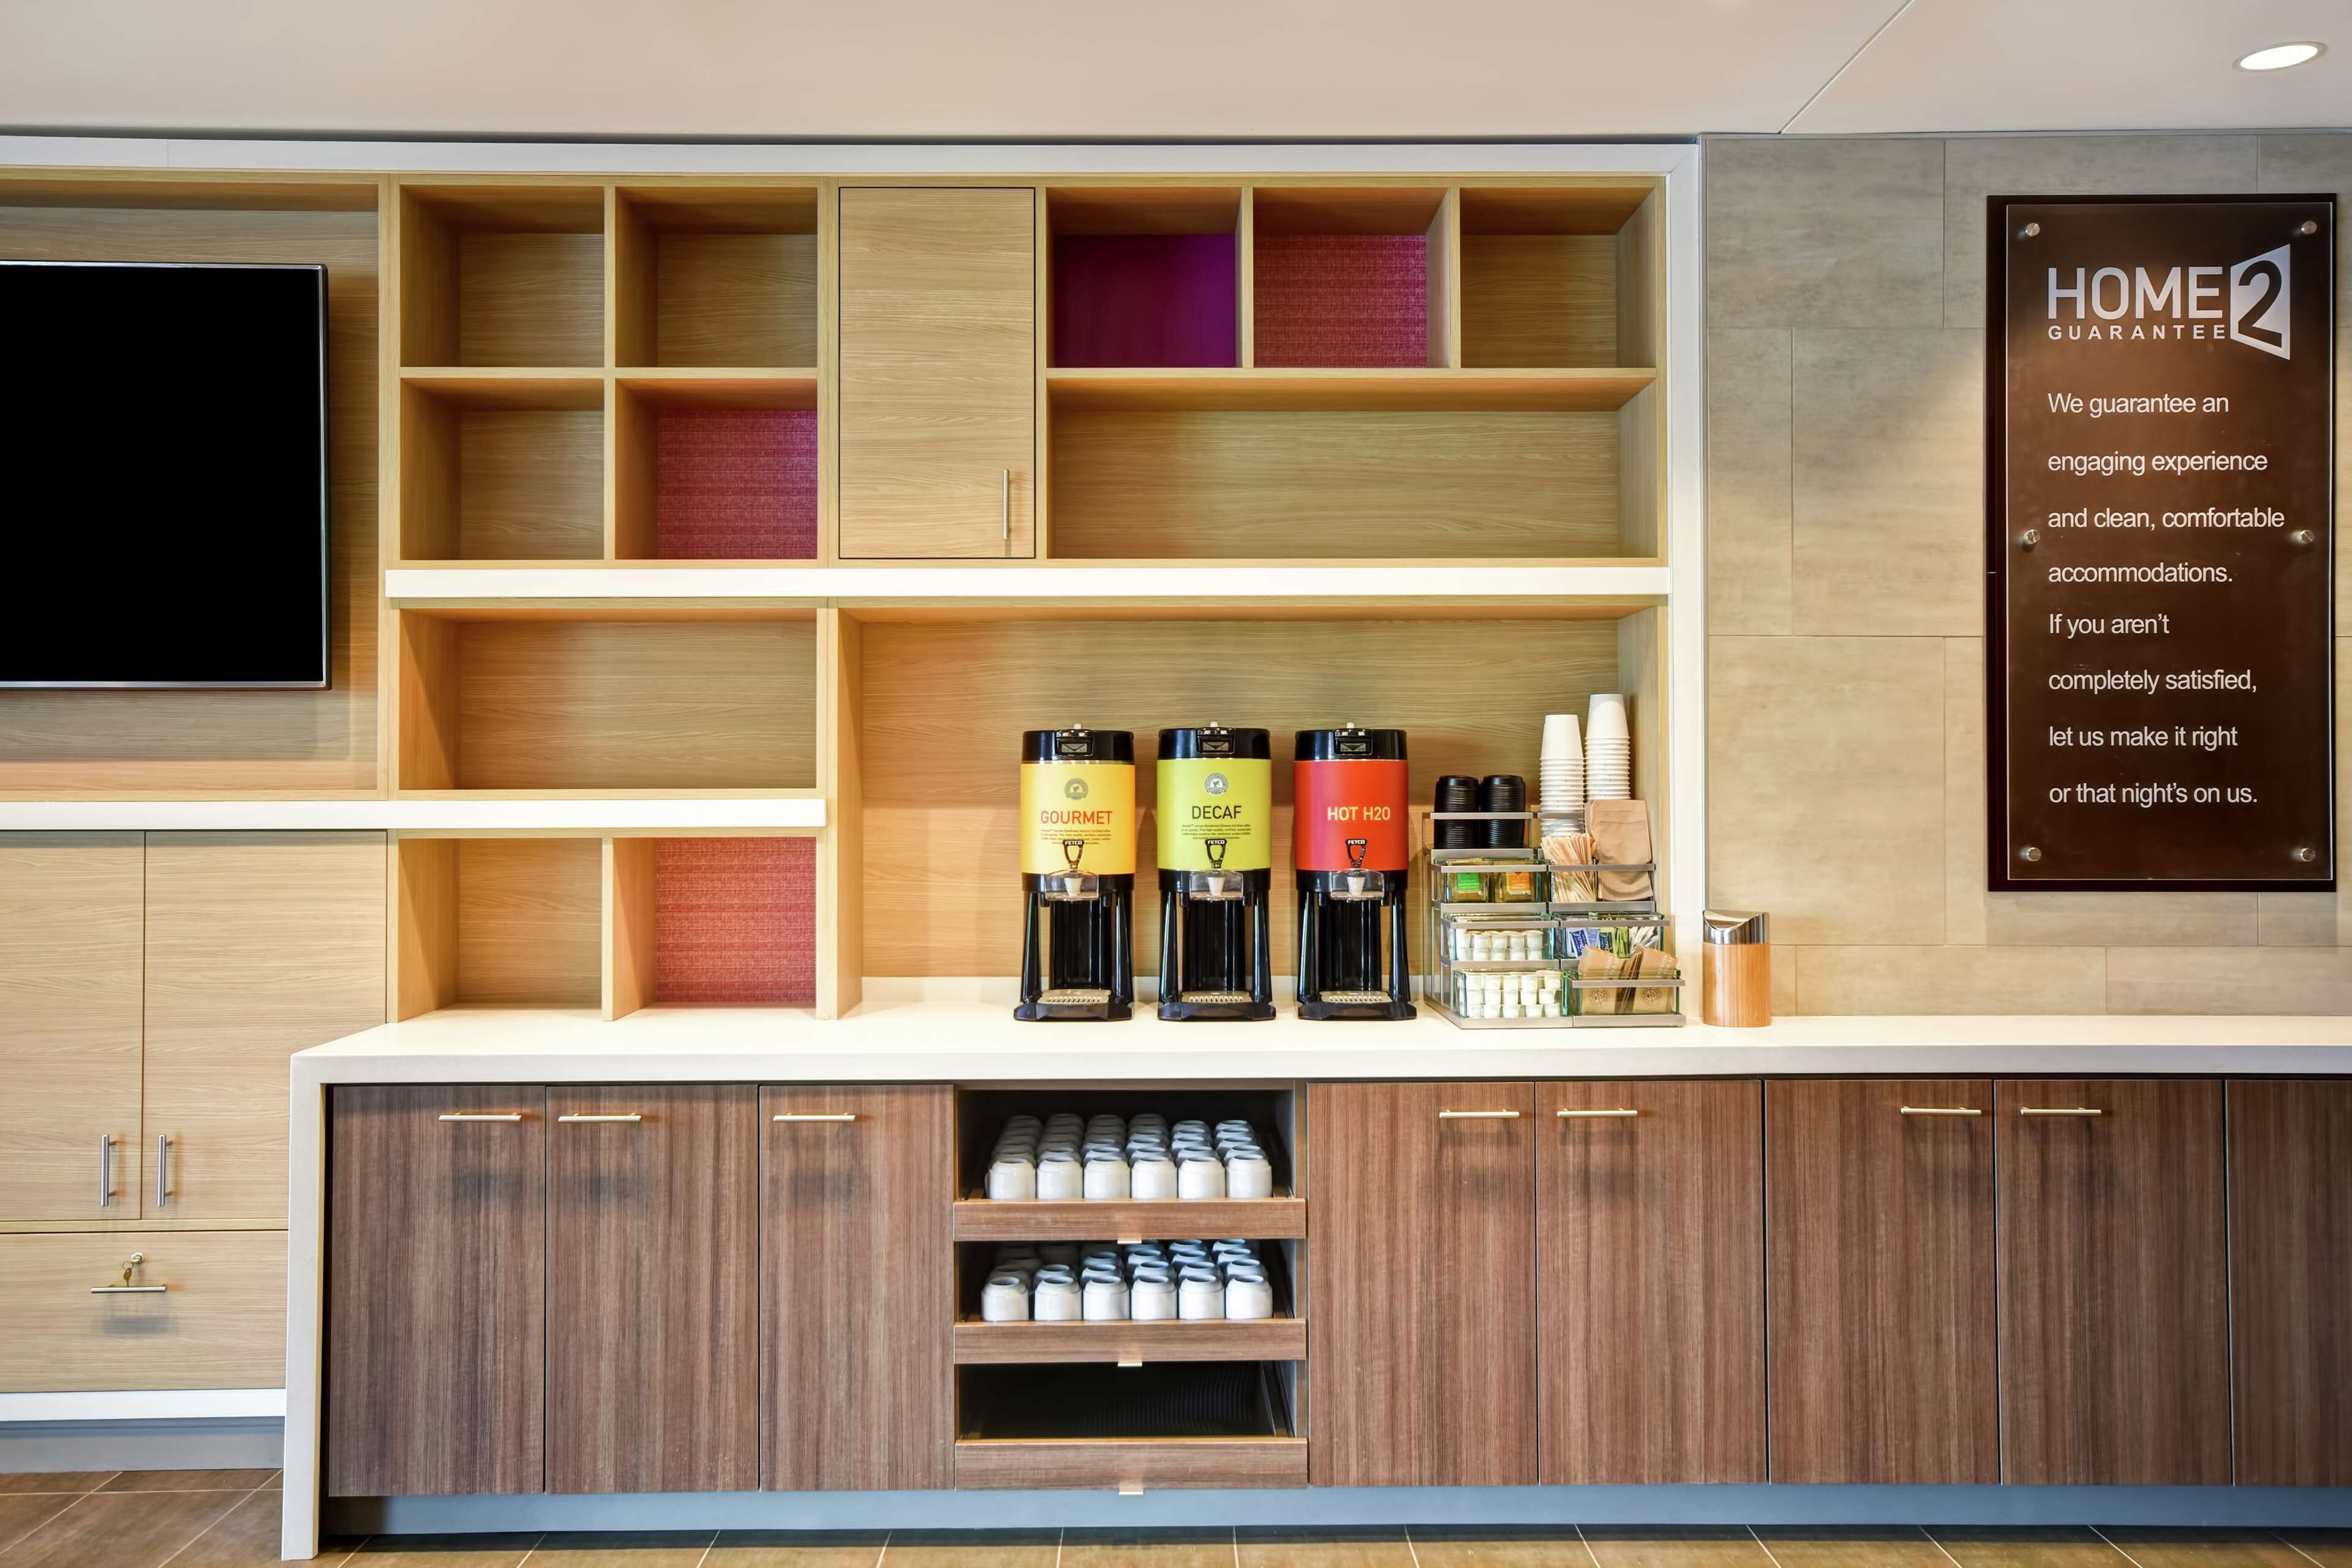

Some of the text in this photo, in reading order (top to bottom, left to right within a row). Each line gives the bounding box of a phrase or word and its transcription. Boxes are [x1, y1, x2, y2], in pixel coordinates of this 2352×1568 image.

[2048, 325, 2225, 340] GUARANTEE
[2048, 393, 2228, 418] We guarantee an
[2048, 451, 2267, 476] engaging experience
[2048, 507, 2284, 530] and clean, comfortable
[2049, 562, 2233, 582] accommodations.
[2050, 614, 2062, 633] If
[2067, 619, 2104, 638] you
[2049, 669, 2256, 695] completely satisfied,
[2050, 726, 2237, 751] let us make it right
[2050, 788, 2071, 802] or
[2076, 783, 2116, 802] that
[2194, 788, 2219, 802] on
[2228, 788, 2257, 802] us.
[1041, 810, 1113, 824] GOURMET
[1192, 805, 1242, 819] DECAF
[1327, 806, 1359, 821] HOT
